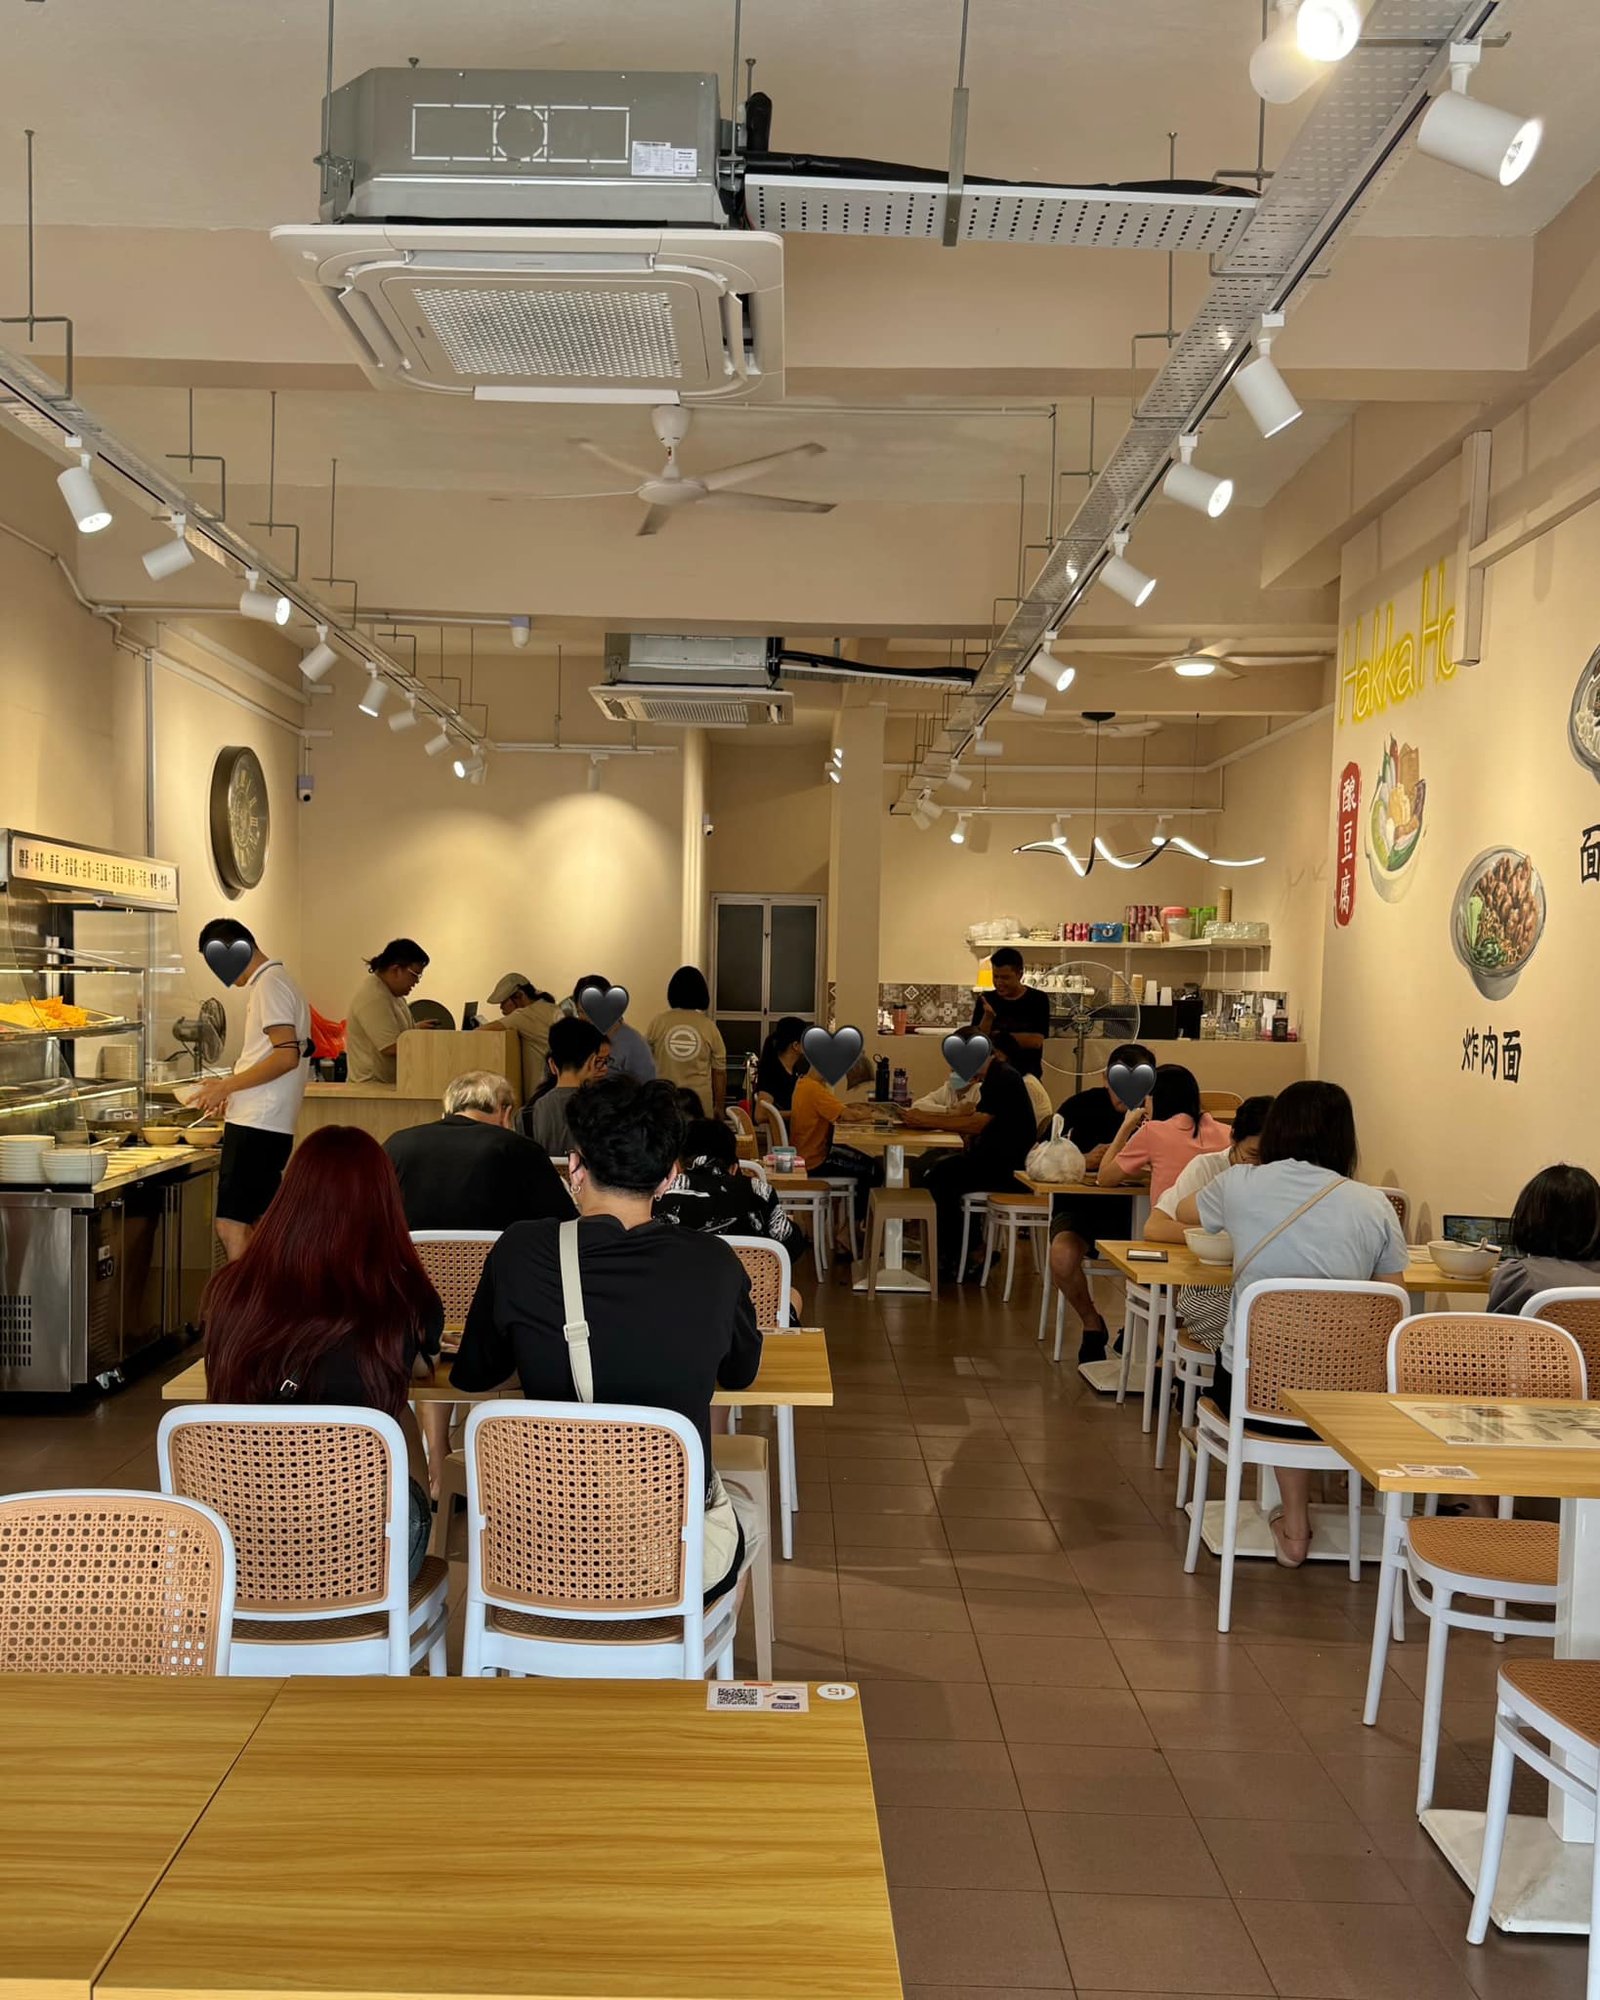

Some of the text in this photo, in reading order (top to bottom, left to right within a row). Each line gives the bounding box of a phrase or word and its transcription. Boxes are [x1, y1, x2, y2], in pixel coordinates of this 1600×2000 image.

[1339, 601, 1415, 726] Hakka
[1461, 1025, 1522, 1084] 炸肉面
